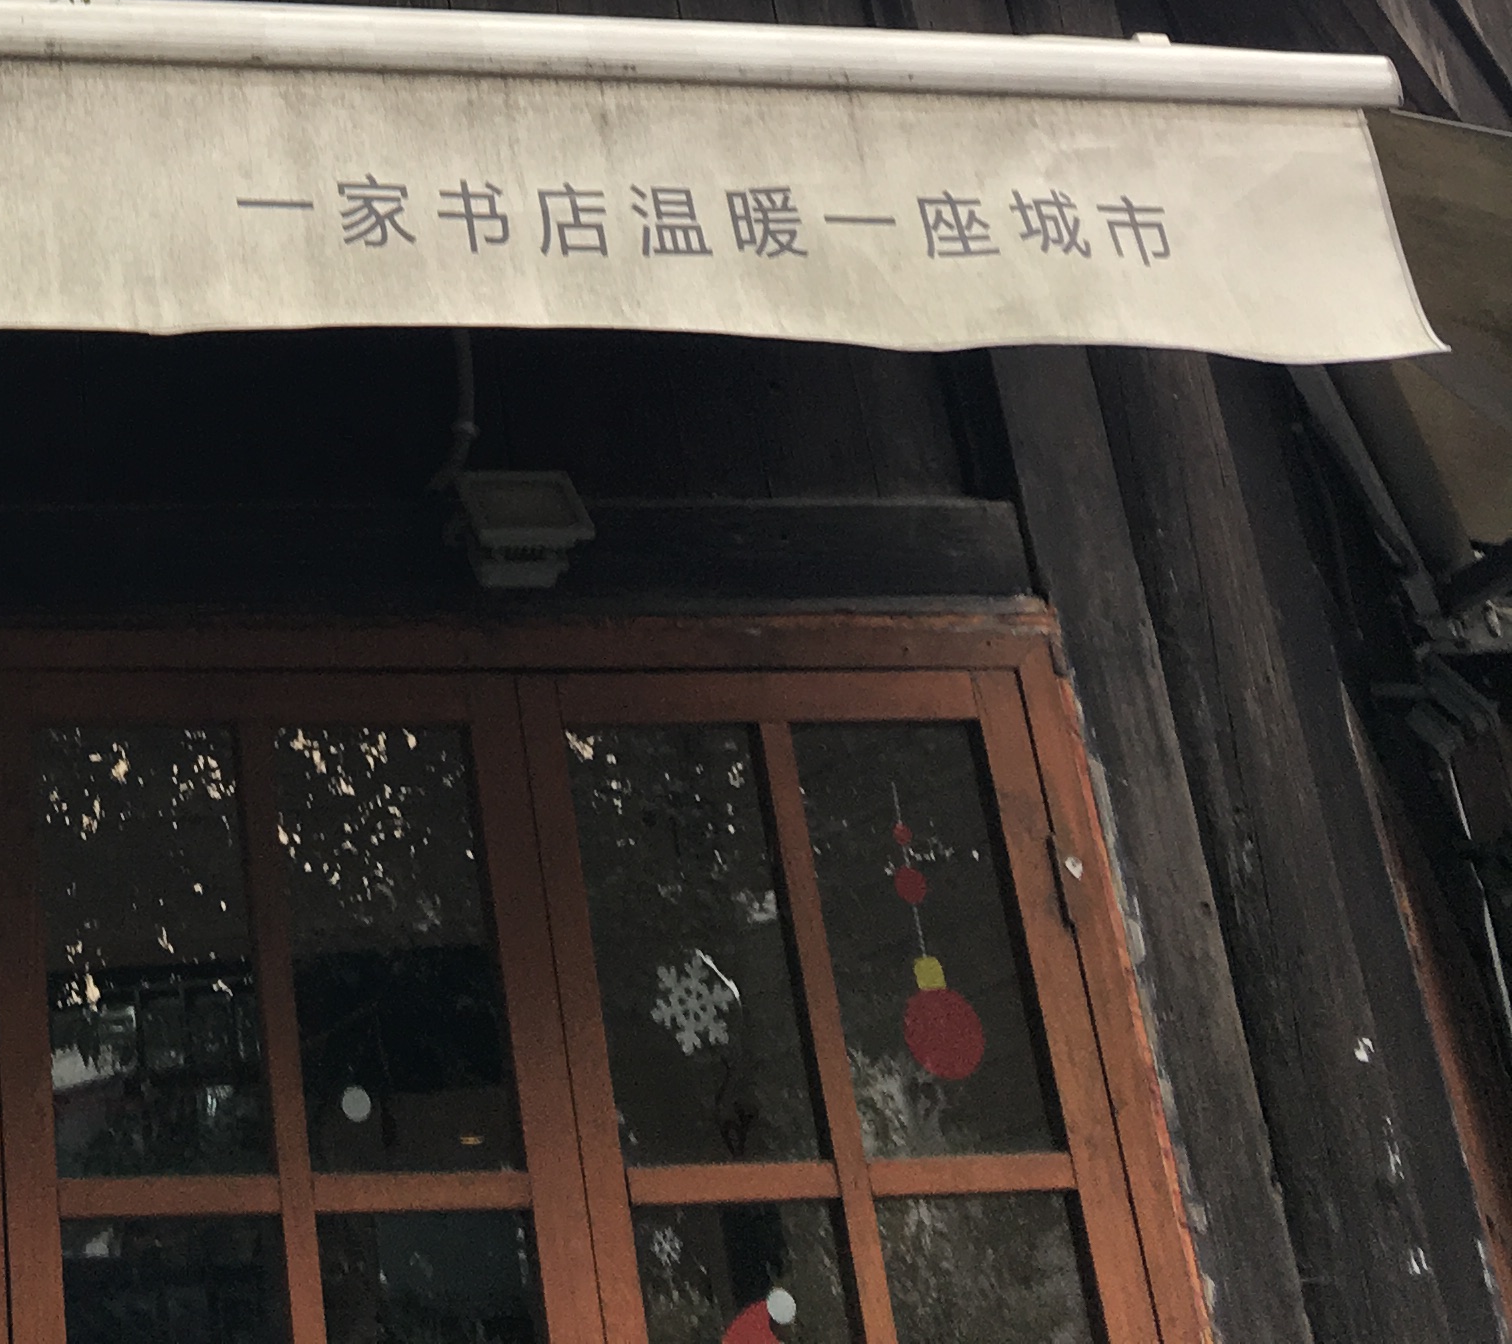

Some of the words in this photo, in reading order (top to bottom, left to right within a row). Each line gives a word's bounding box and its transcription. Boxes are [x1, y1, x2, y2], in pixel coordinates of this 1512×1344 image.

[236, 173, 1172, 269] 一家书店温暖一座城市
